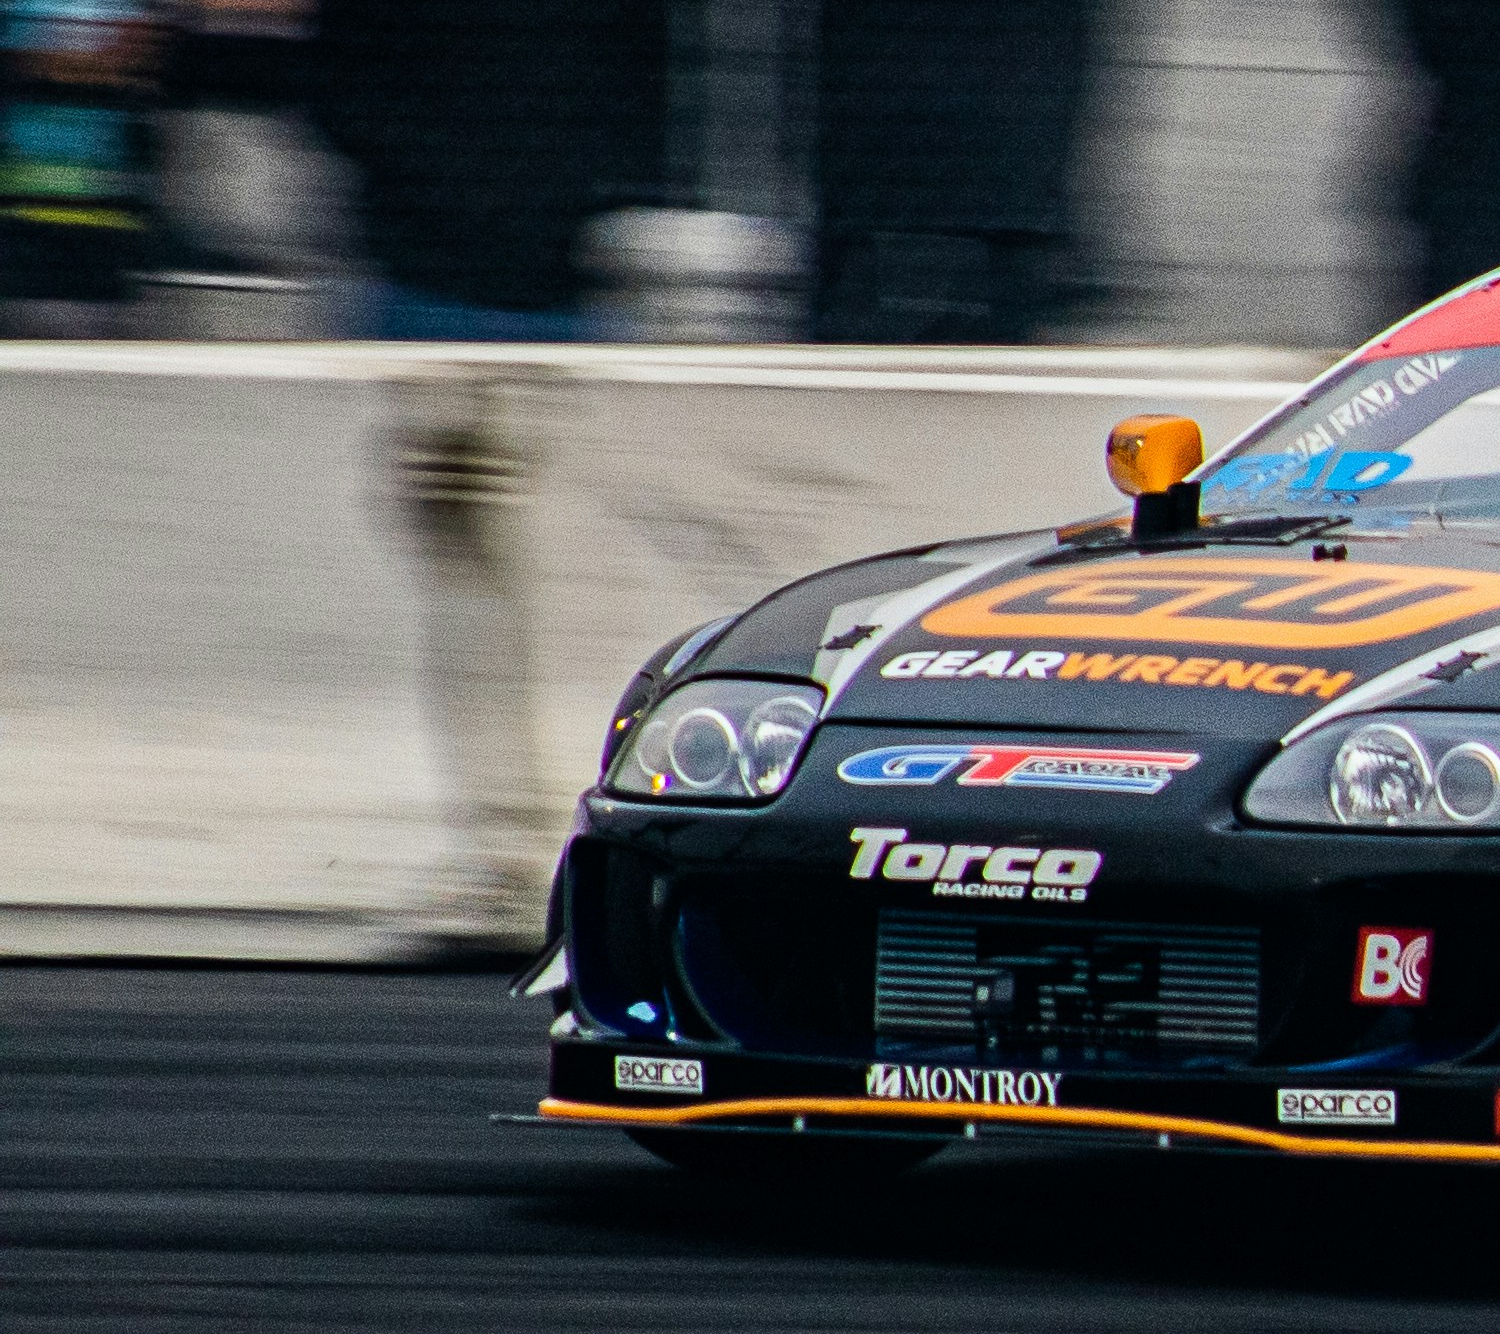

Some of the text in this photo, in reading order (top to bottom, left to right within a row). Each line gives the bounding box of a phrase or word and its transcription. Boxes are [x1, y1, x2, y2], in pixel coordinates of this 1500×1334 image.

[881, 650, 1355, 699] GEARWRENCH
[850, 827, 1102, 882] Torco
[932, 881, 1087, 903] RACING OILS
[904, 1069, 1062, 1105] MONTROY
[1282, 1093, 1392, 1120] sparco
